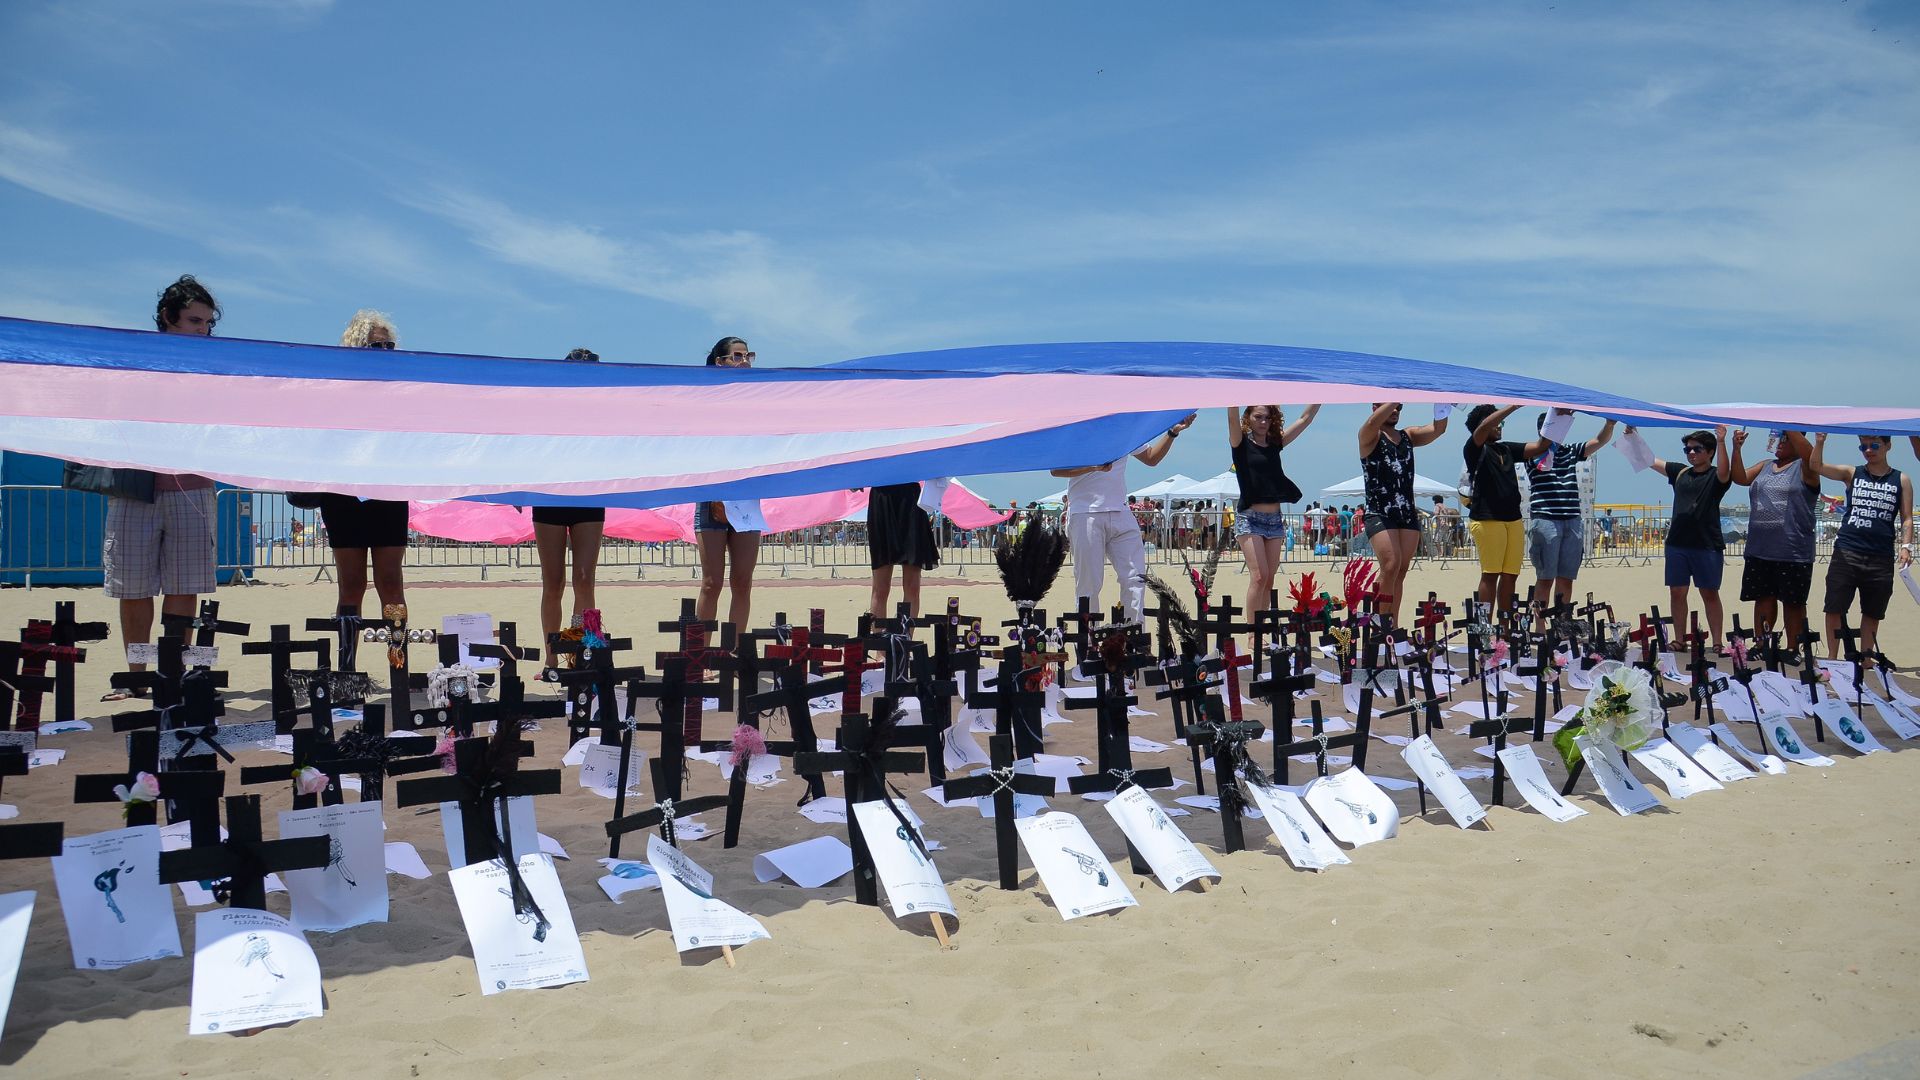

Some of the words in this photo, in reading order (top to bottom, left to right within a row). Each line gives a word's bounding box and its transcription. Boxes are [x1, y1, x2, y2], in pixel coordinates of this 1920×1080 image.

[1853, 478, 1898, 493] Ubatuba
[1852, 488, 1897, 503] Maresias
[1851, 497, 1895, 511] Itacoatiara
[1851, 506, 1877, 519] Praia
[1878, 510, 1892, 521] da
[1847, 516, 1872, 528] Pipa
